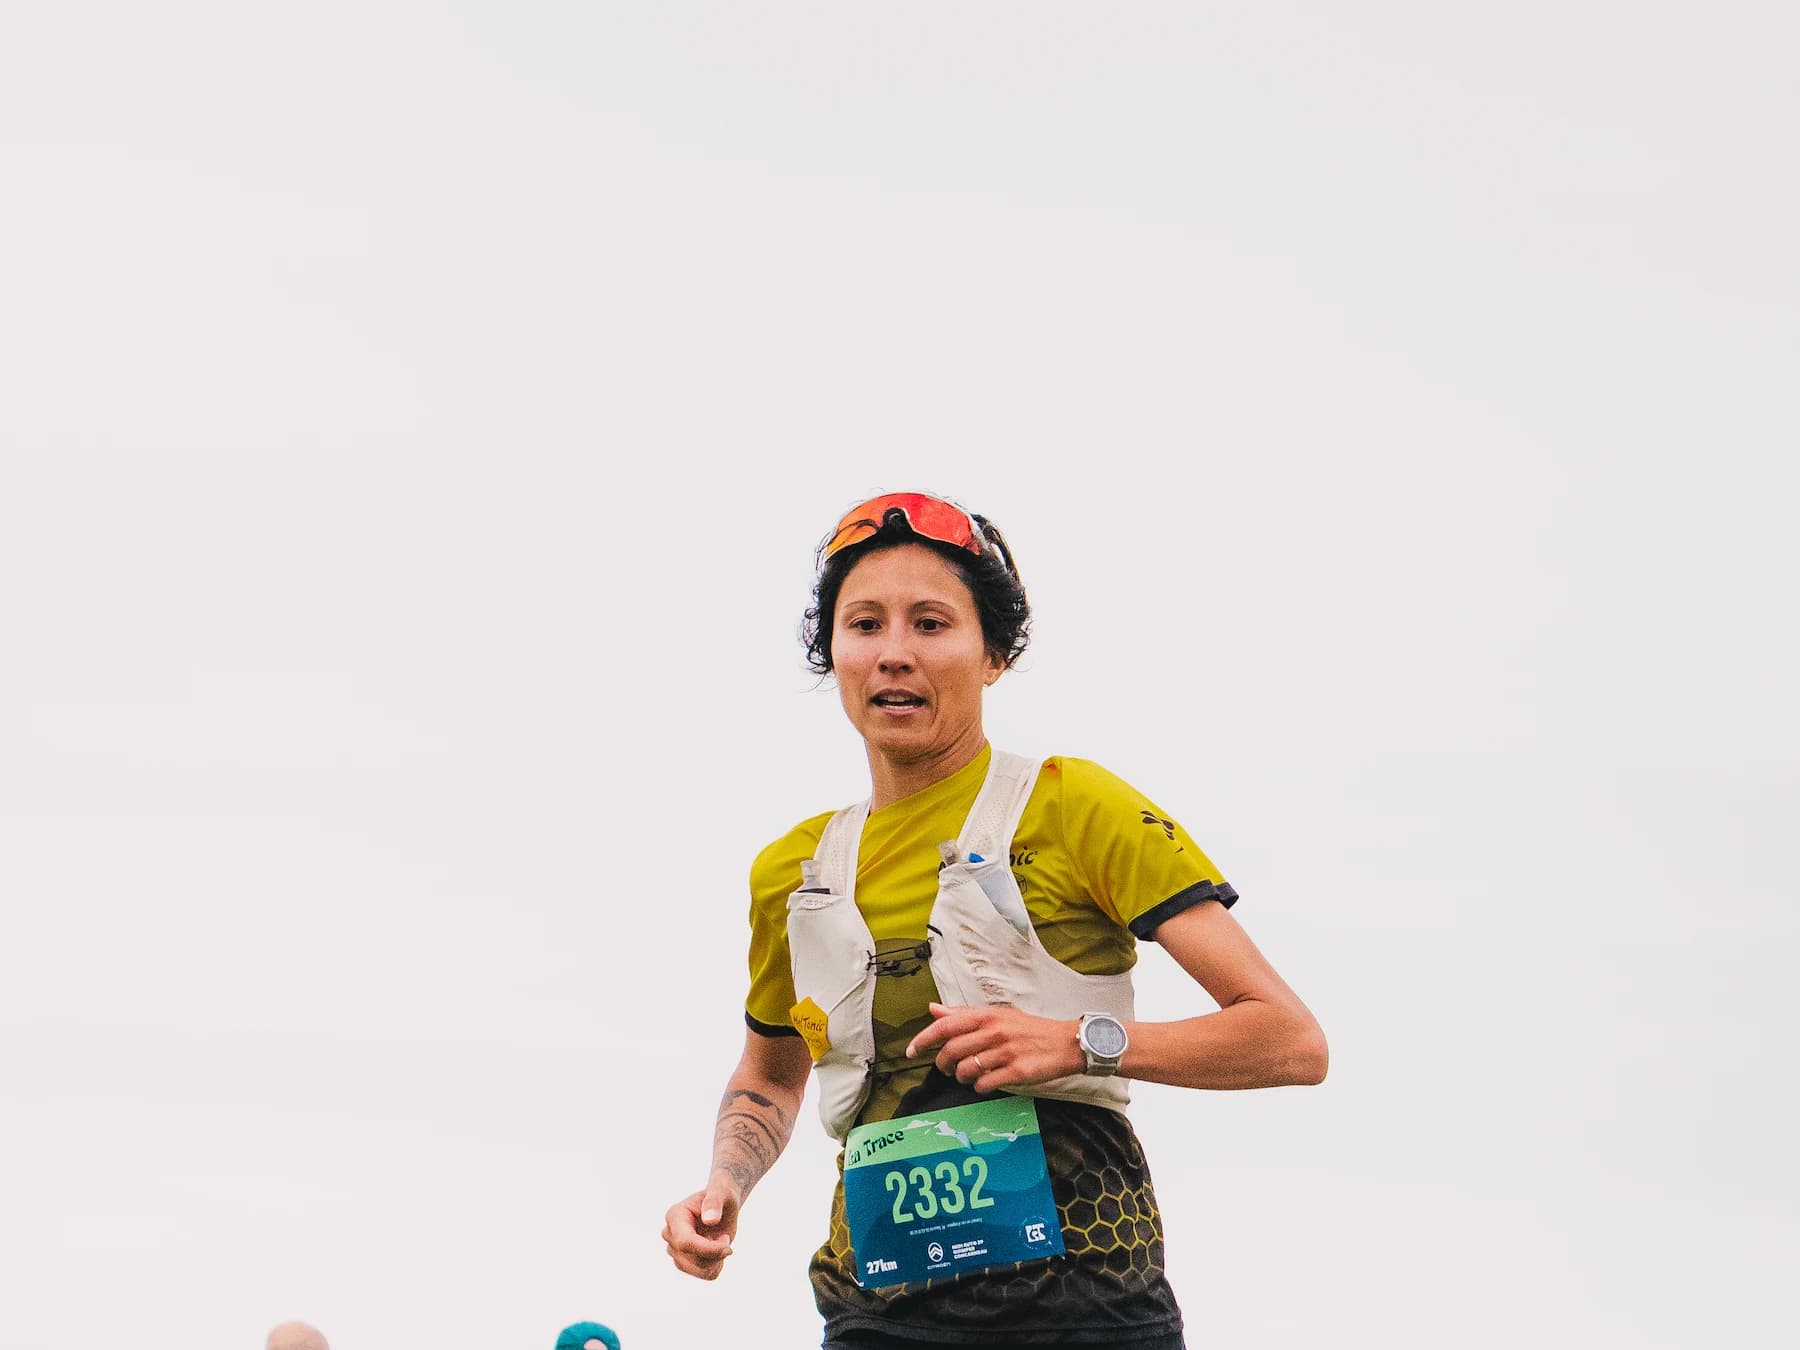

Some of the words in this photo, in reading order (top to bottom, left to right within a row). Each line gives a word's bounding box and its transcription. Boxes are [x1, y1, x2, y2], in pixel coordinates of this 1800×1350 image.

[863, 1130, 905, 1157] Trace
[885, 1155, 995, 1224] 2332
[866, 1258, 898, 1275] 27km
